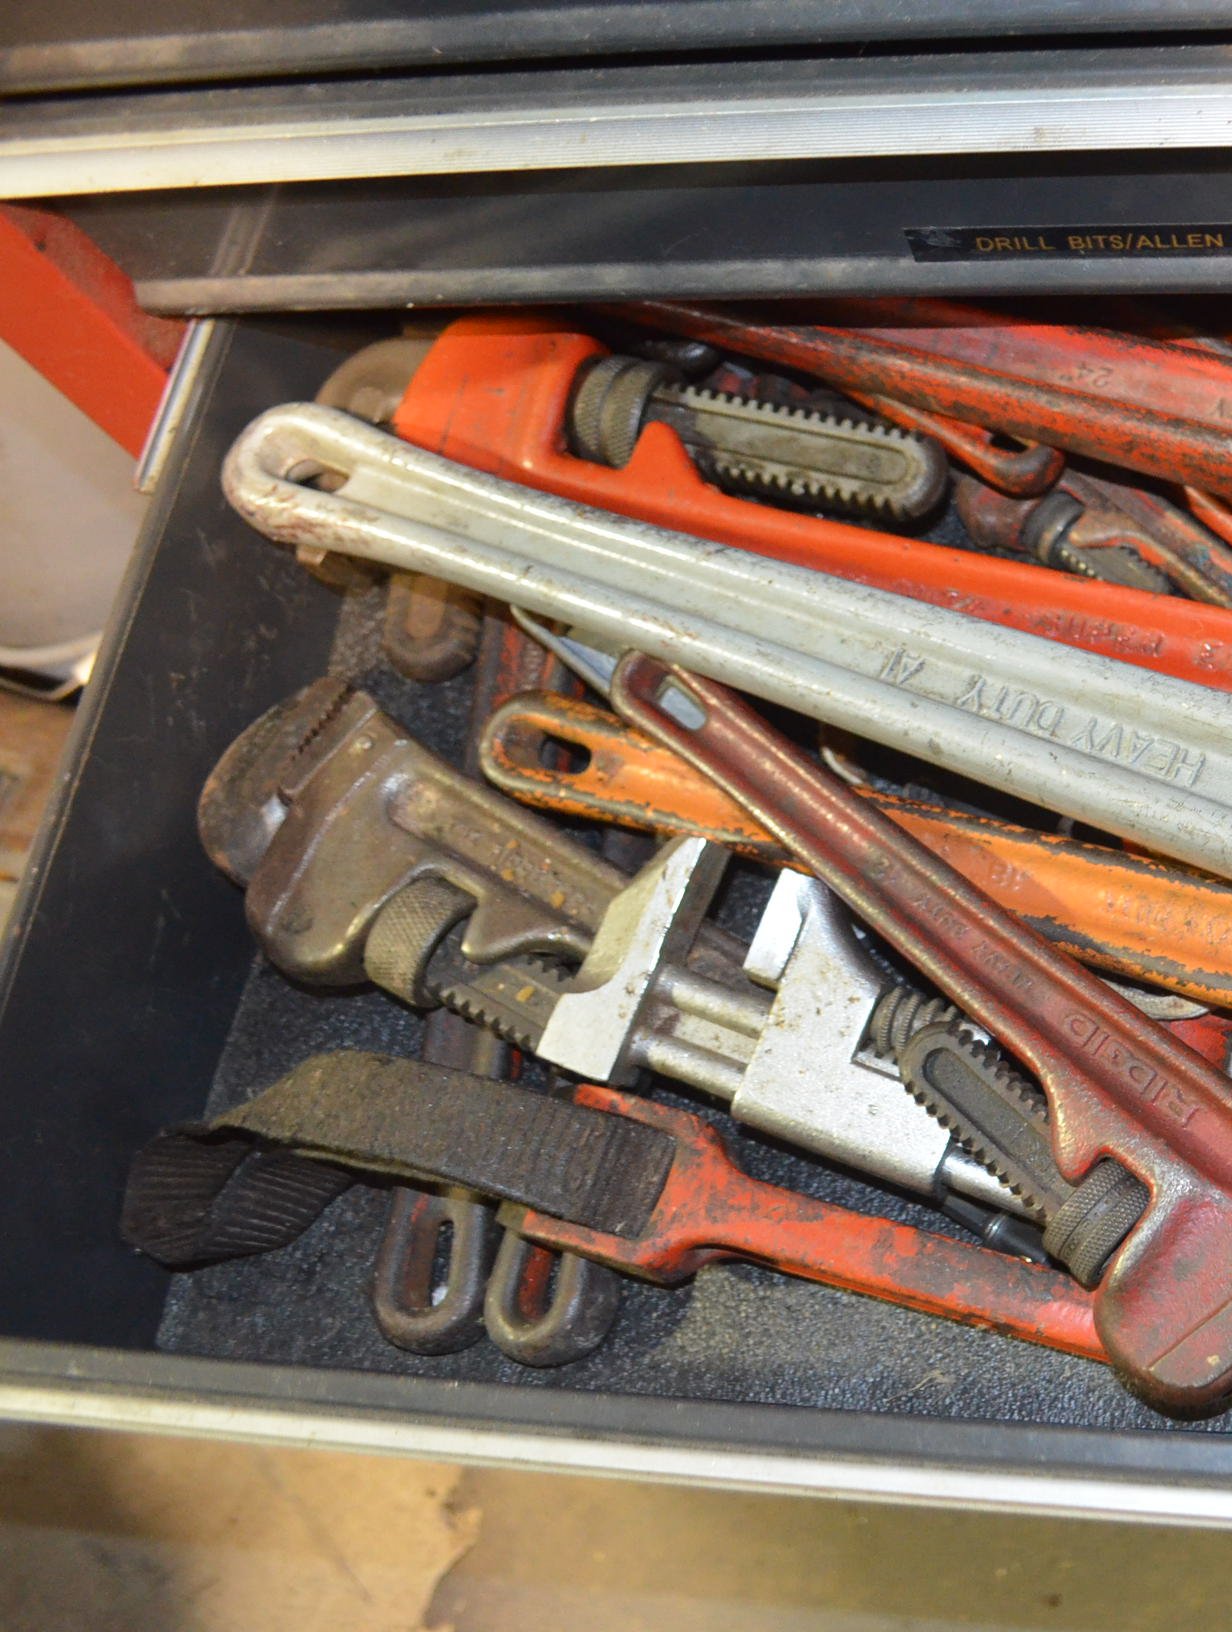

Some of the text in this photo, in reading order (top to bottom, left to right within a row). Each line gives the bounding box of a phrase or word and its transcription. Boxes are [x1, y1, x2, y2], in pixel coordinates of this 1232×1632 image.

[975, 234, 1053, 253] DRILL
[1068, 232, 1224, 251] BITS/ALLEN
[957, 672, 1066, 740] DUTY
[1071, 714, 1207, 787] HEAVY
